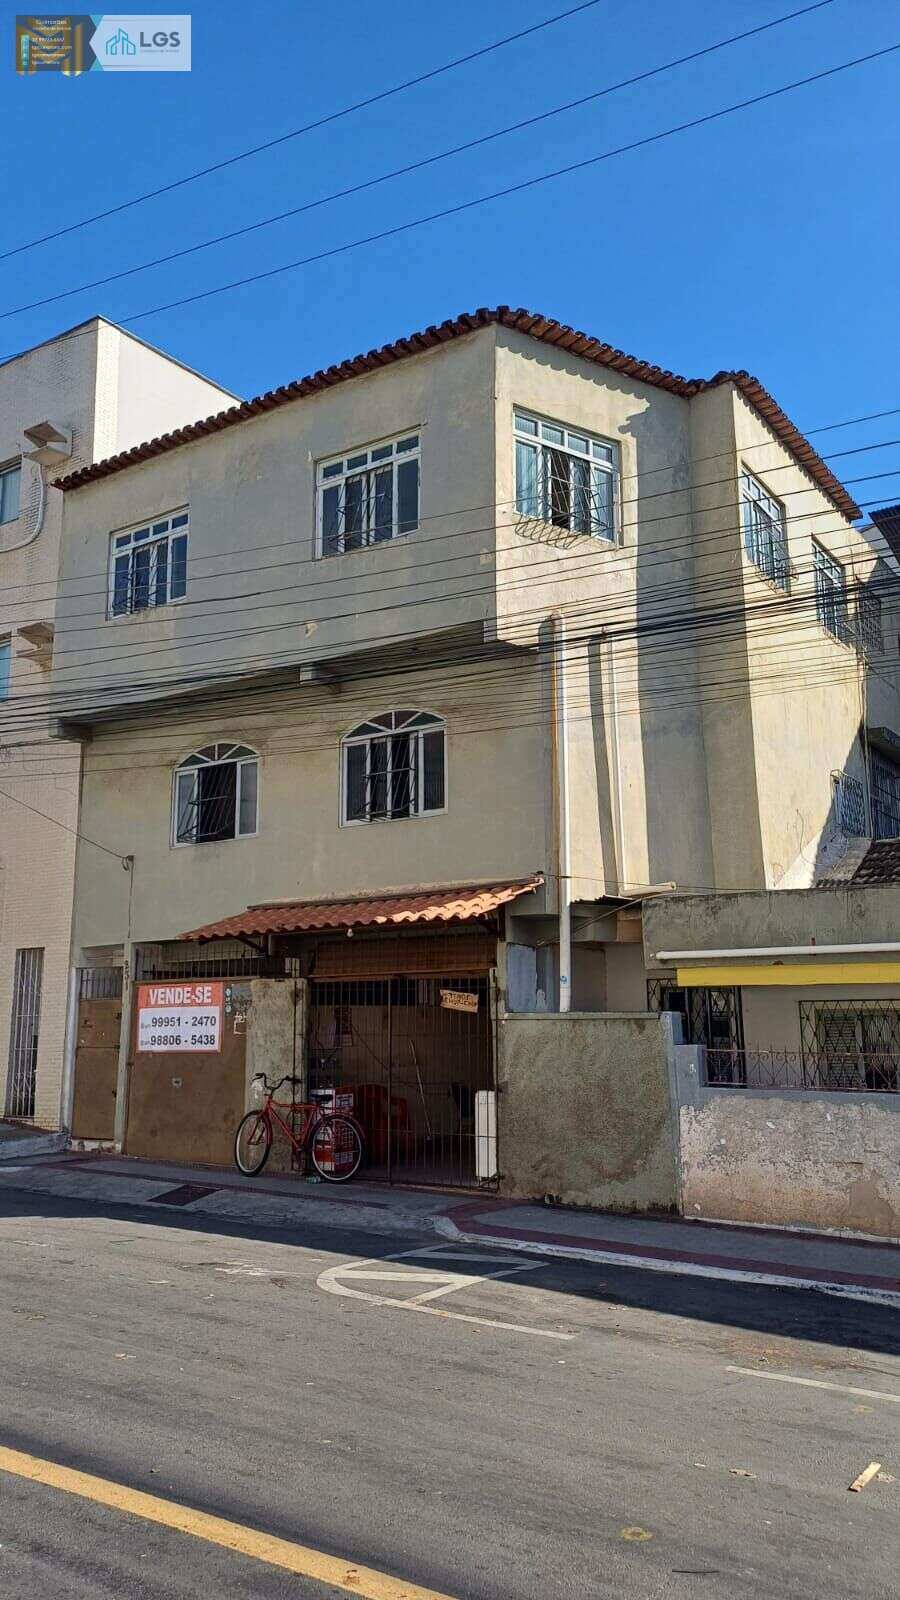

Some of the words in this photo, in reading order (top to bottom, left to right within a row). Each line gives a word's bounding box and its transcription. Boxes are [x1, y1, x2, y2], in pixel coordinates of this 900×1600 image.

[149, 986, 212, 1005] VENDE-SE
[152, 1016, 181, 1028] 99951
[191, 1016, 217, 1027] 2470
[150, 1035, 182, 1046] 98806
[191, 1034, 216, 1045] 5438
